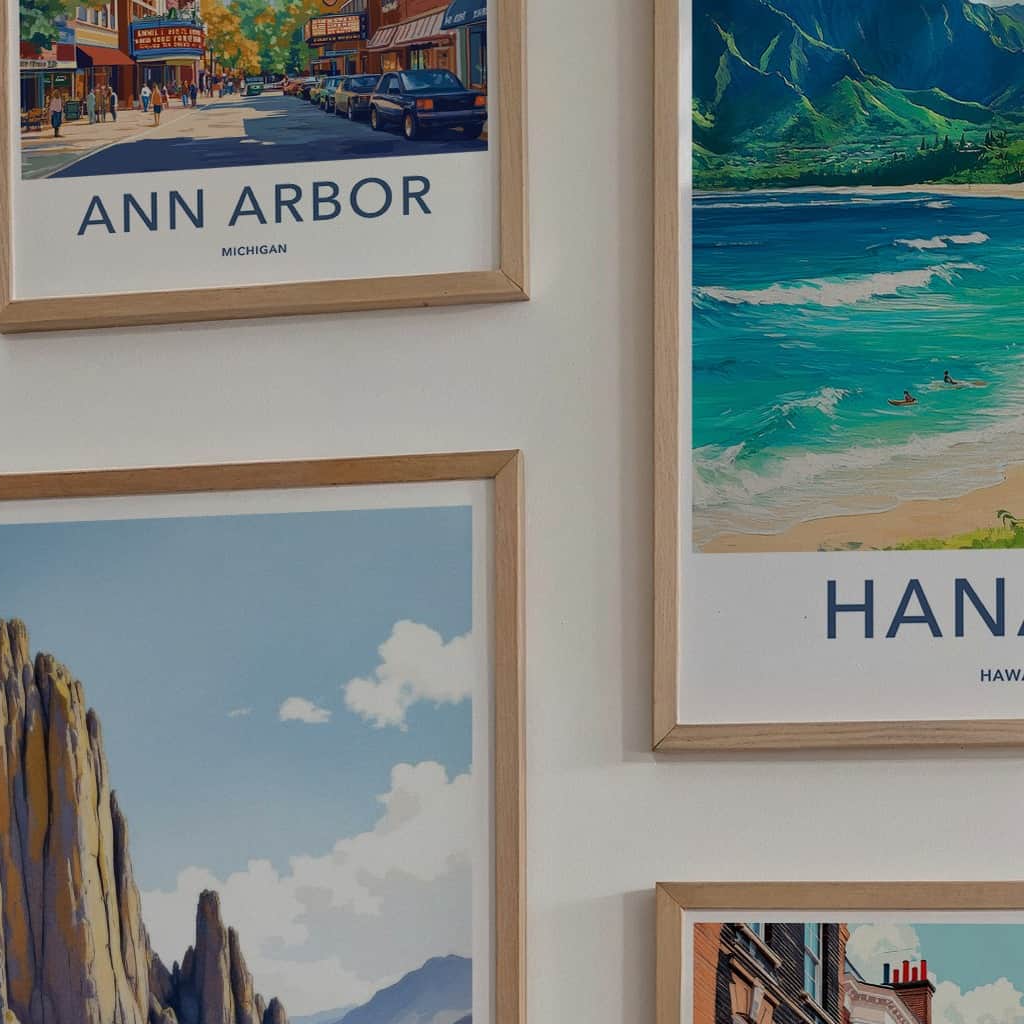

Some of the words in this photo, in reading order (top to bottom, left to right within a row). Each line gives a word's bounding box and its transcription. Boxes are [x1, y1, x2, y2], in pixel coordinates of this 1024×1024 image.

[77, 188, 204, 236] ANN
[228, 175, 432, 227] ARBOR
[221, 243, 287, 257] MICHIGAN
[827, 577, 1024, 639] HAN
